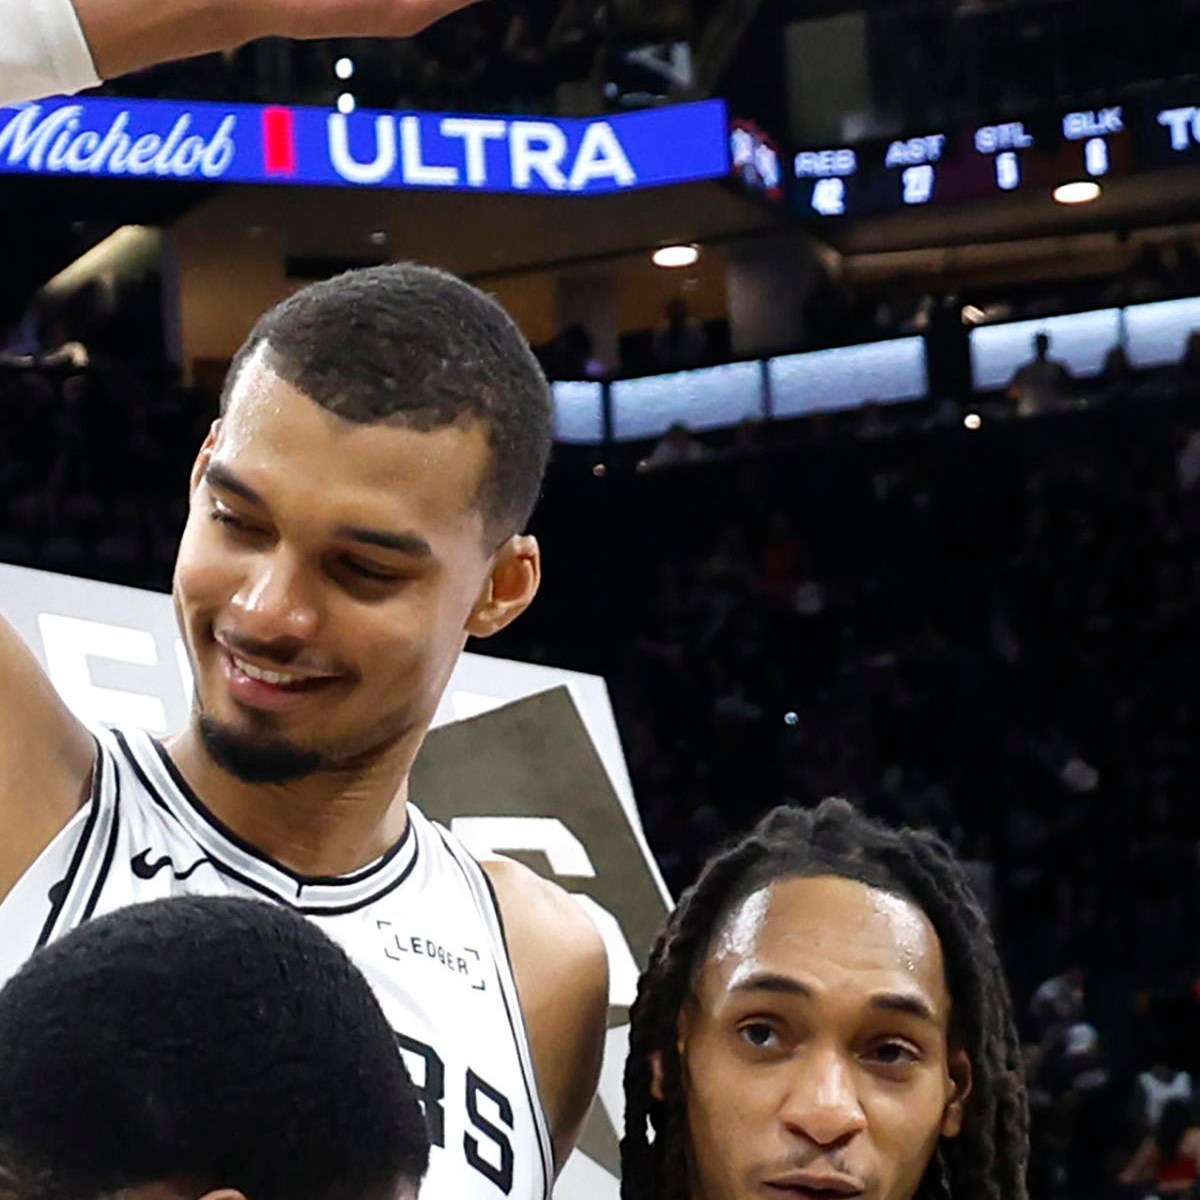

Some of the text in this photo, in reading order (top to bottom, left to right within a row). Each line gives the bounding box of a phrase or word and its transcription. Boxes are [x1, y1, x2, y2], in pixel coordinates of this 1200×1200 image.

[327, 112, 636, 191] ULTRA
[885, 133, 946, 168] AST
[974, 121, 1033, 154] STL
[1062, 105, 1125, 140] BLK
[394, 934, 469, 976] LEDGER
